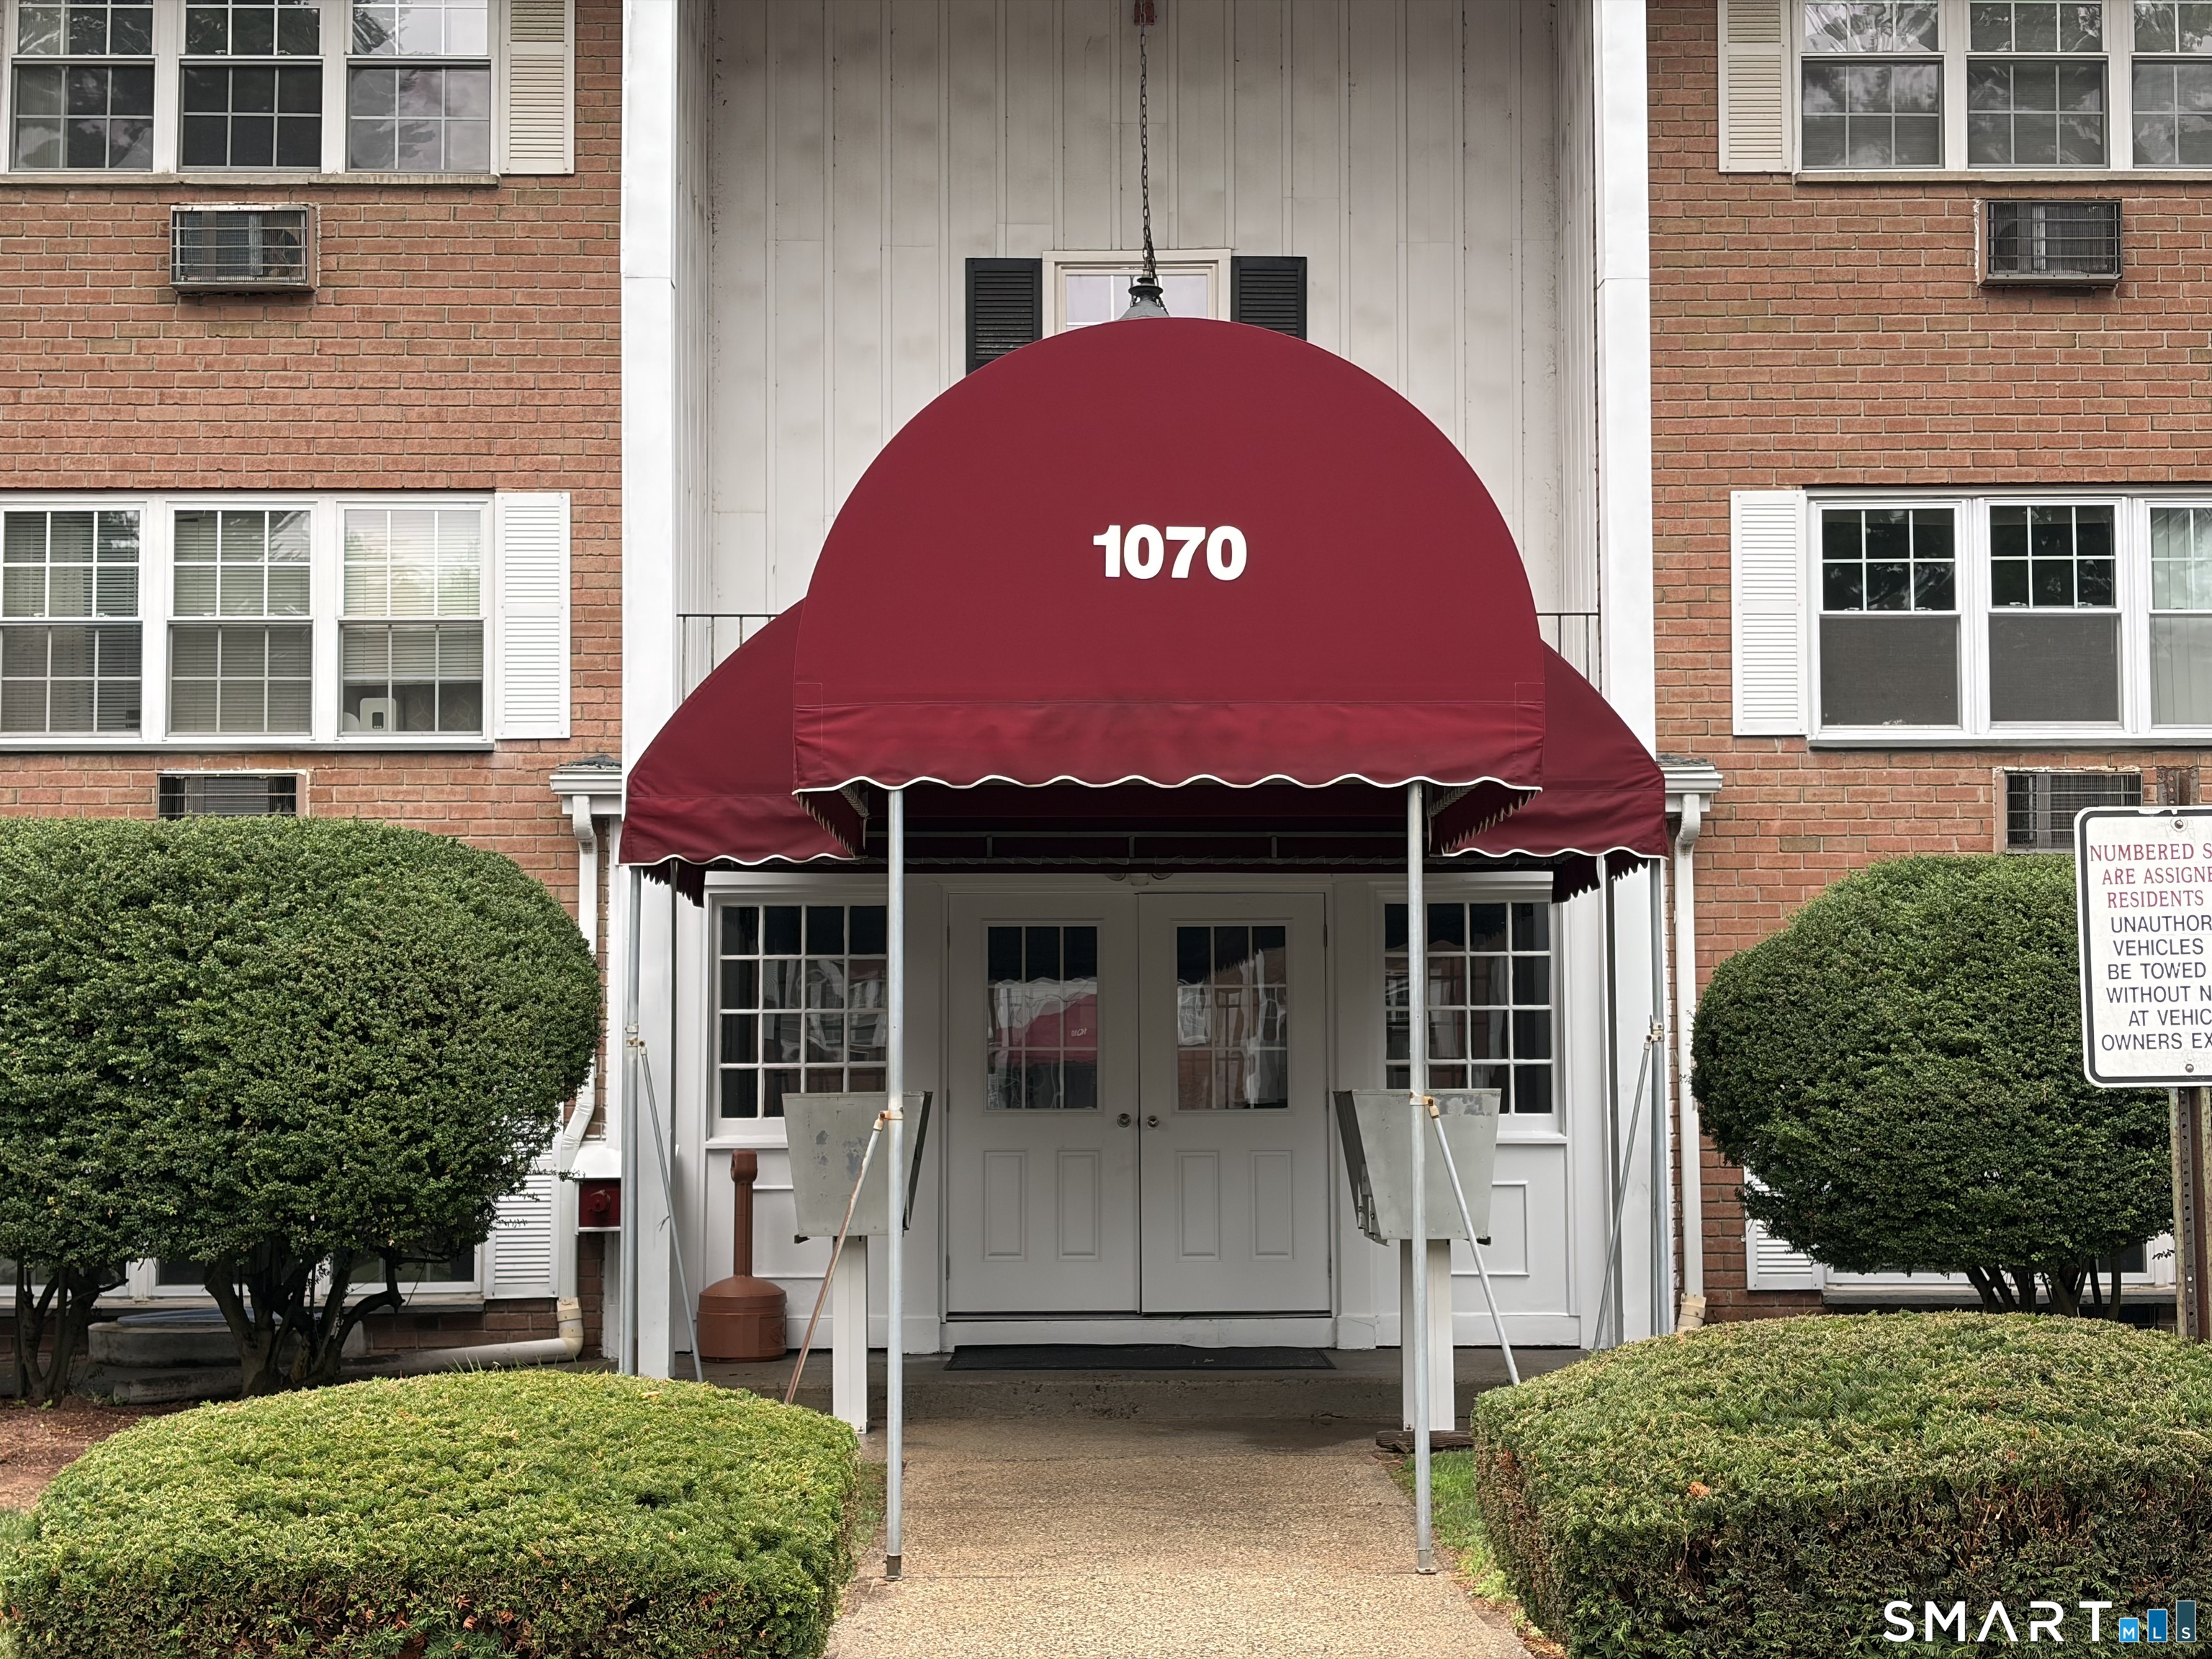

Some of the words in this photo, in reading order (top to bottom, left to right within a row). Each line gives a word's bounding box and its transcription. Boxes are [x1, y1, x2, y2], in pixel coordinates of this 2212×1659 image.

[1093, 523, 1247, 581] 1070
[2090, 843, 2194, 861] NUMBERED
[2102, 868, 2136, 885] ARE
[2107, 890, 2204, 908] RESIDENTS
[2111, 914, 2212, 933] UNAUTHOR
[2113, 938, 2204, 956] VEHICLES
[2108, 963, 2132, 980] BE
[2140, 962, 2206, 979] TOWED
[2106, 986, 2191, 1003] WITHOUT
[2128, 1010, 2149, 1027] AT
[2157, 1008, 2212, 1026] VEHIC
[2101, 1033, 2182, 1051] OWNERS
[2192, 1032, 2212, 1049] EX
